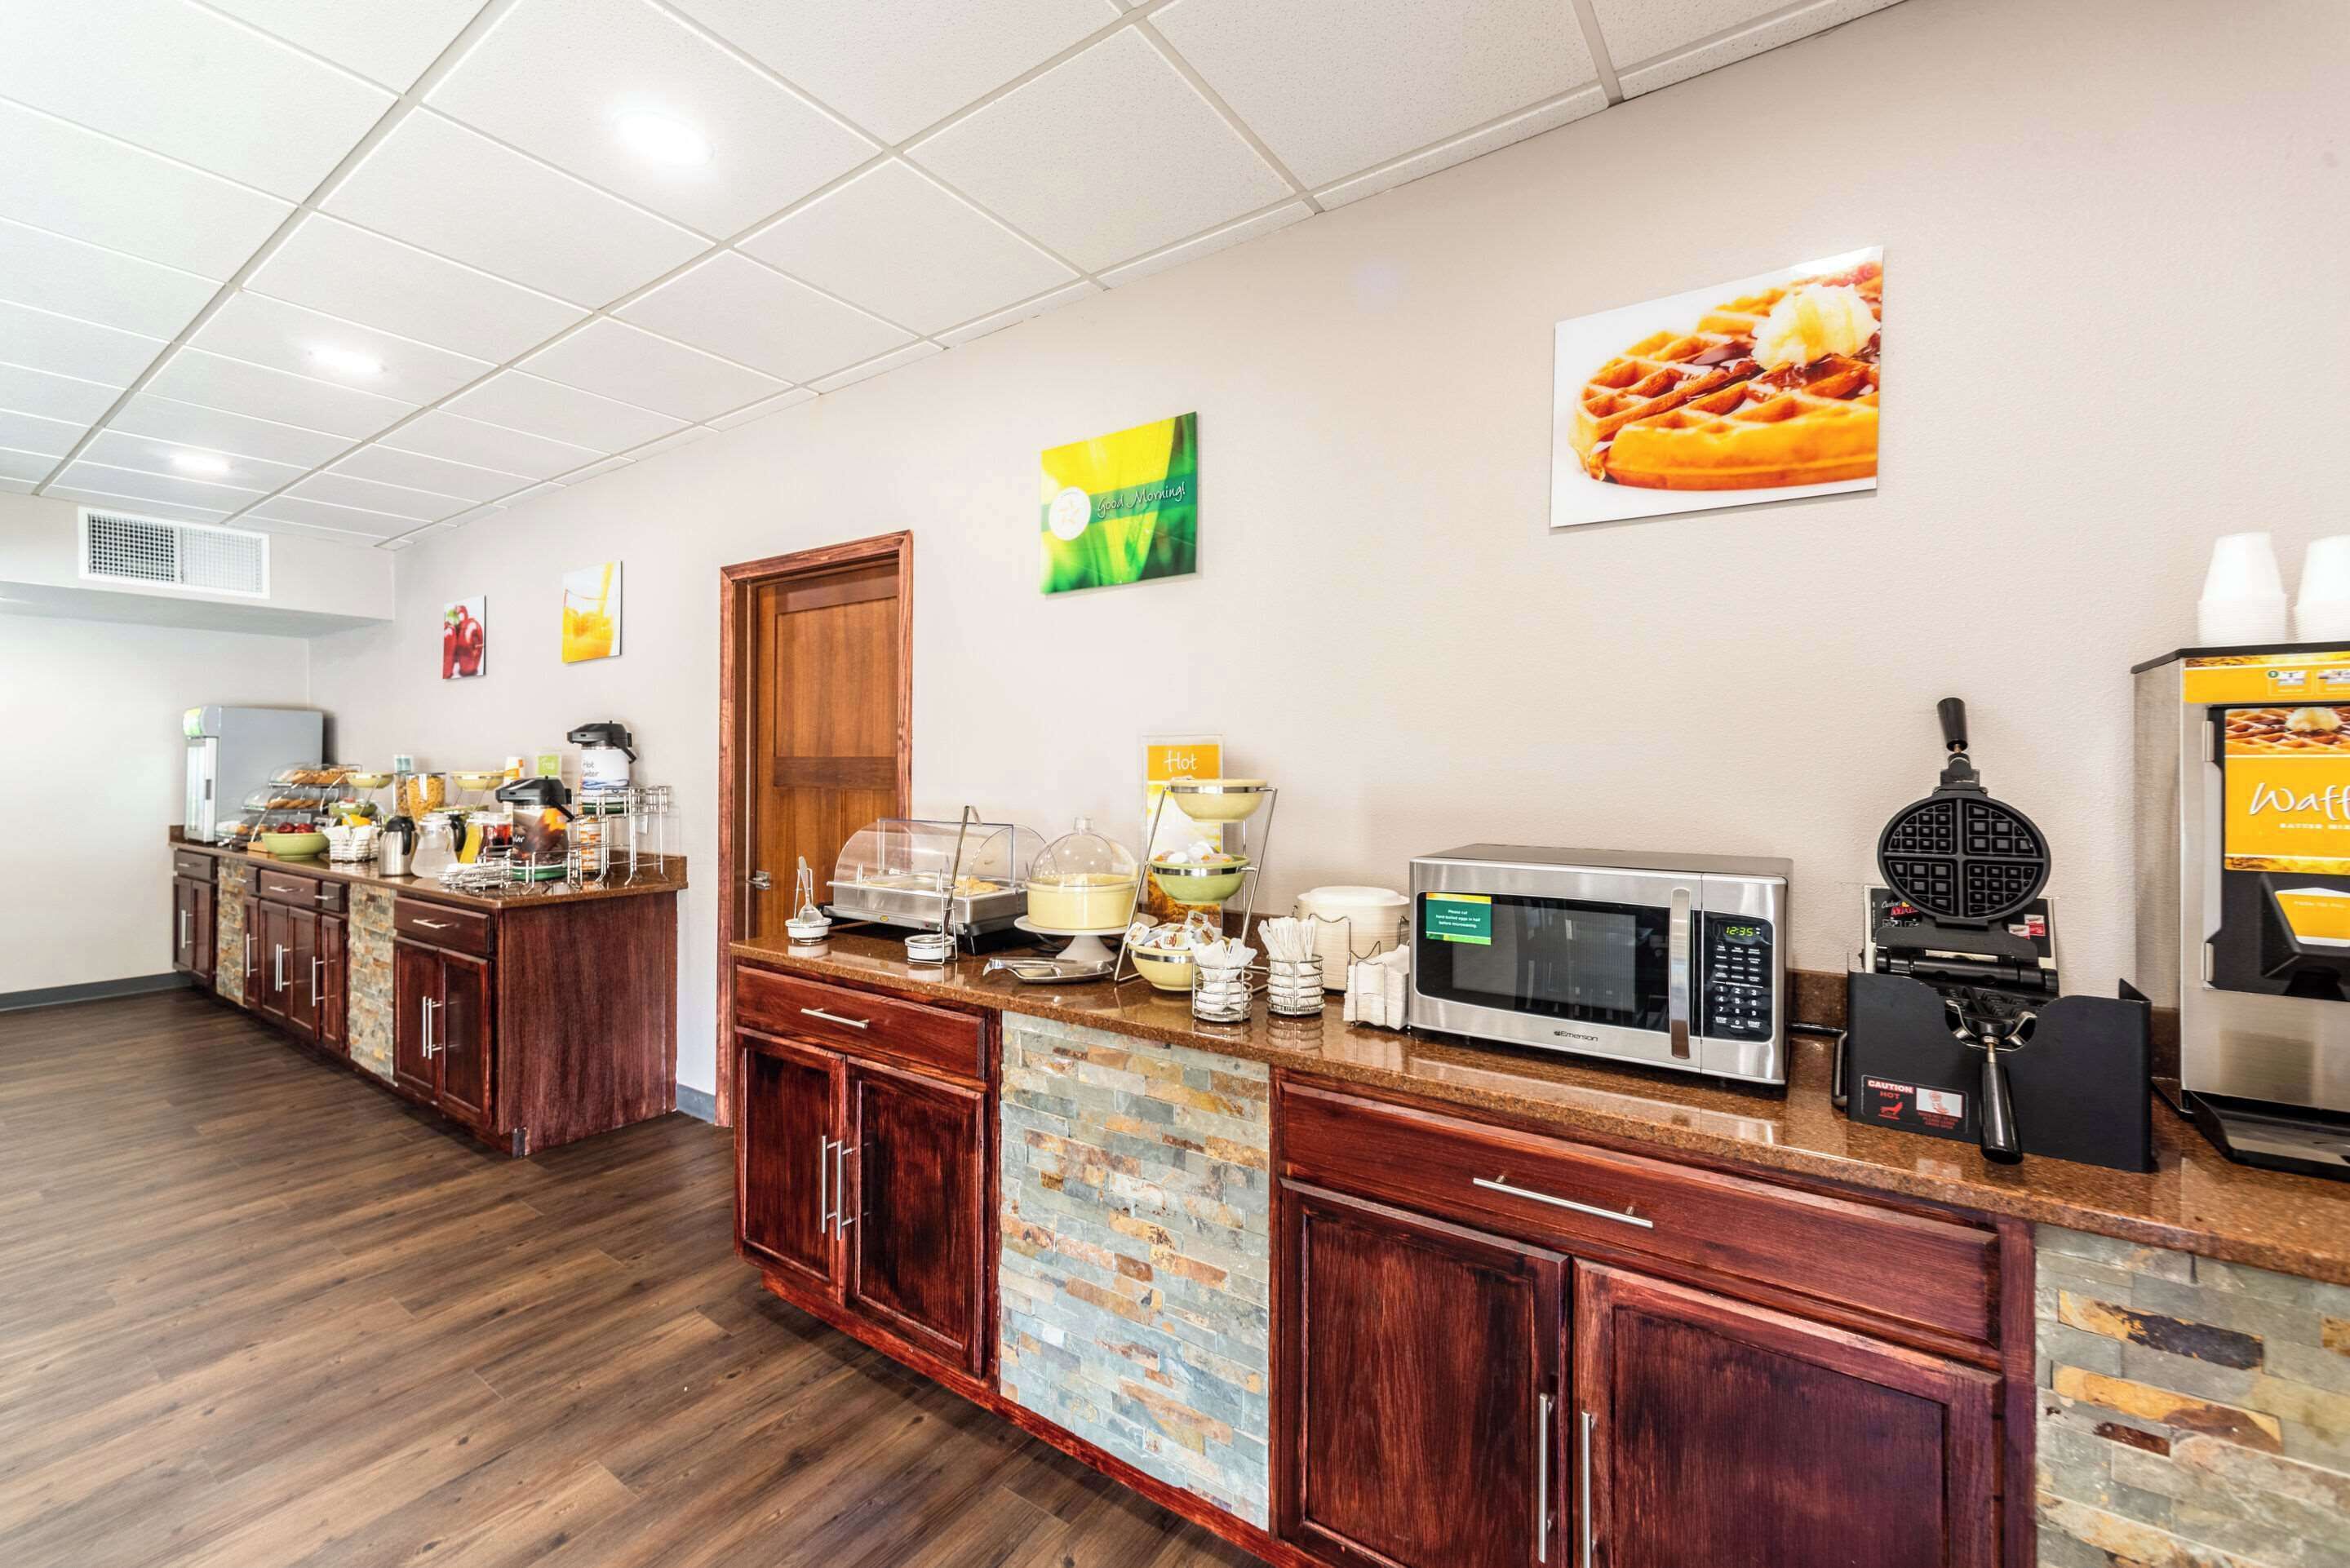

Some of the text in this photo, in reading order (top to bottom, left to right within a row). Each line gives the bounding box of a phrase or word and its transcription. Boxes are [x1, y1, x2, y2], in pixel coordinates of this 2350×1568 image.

[1097, 481, 1186, 519] Good Morning!
[583, 759, 595, 768] Hot
[1163, 750, 1199, 773] Hot
[1726, 926, 1754, 937] 12:35
[1560, 1030, 1598, 1042] Emerson
[1867, 1079, 1914, 1094] CAUTION
[1879, 1091, 1900, 1100] HOT
